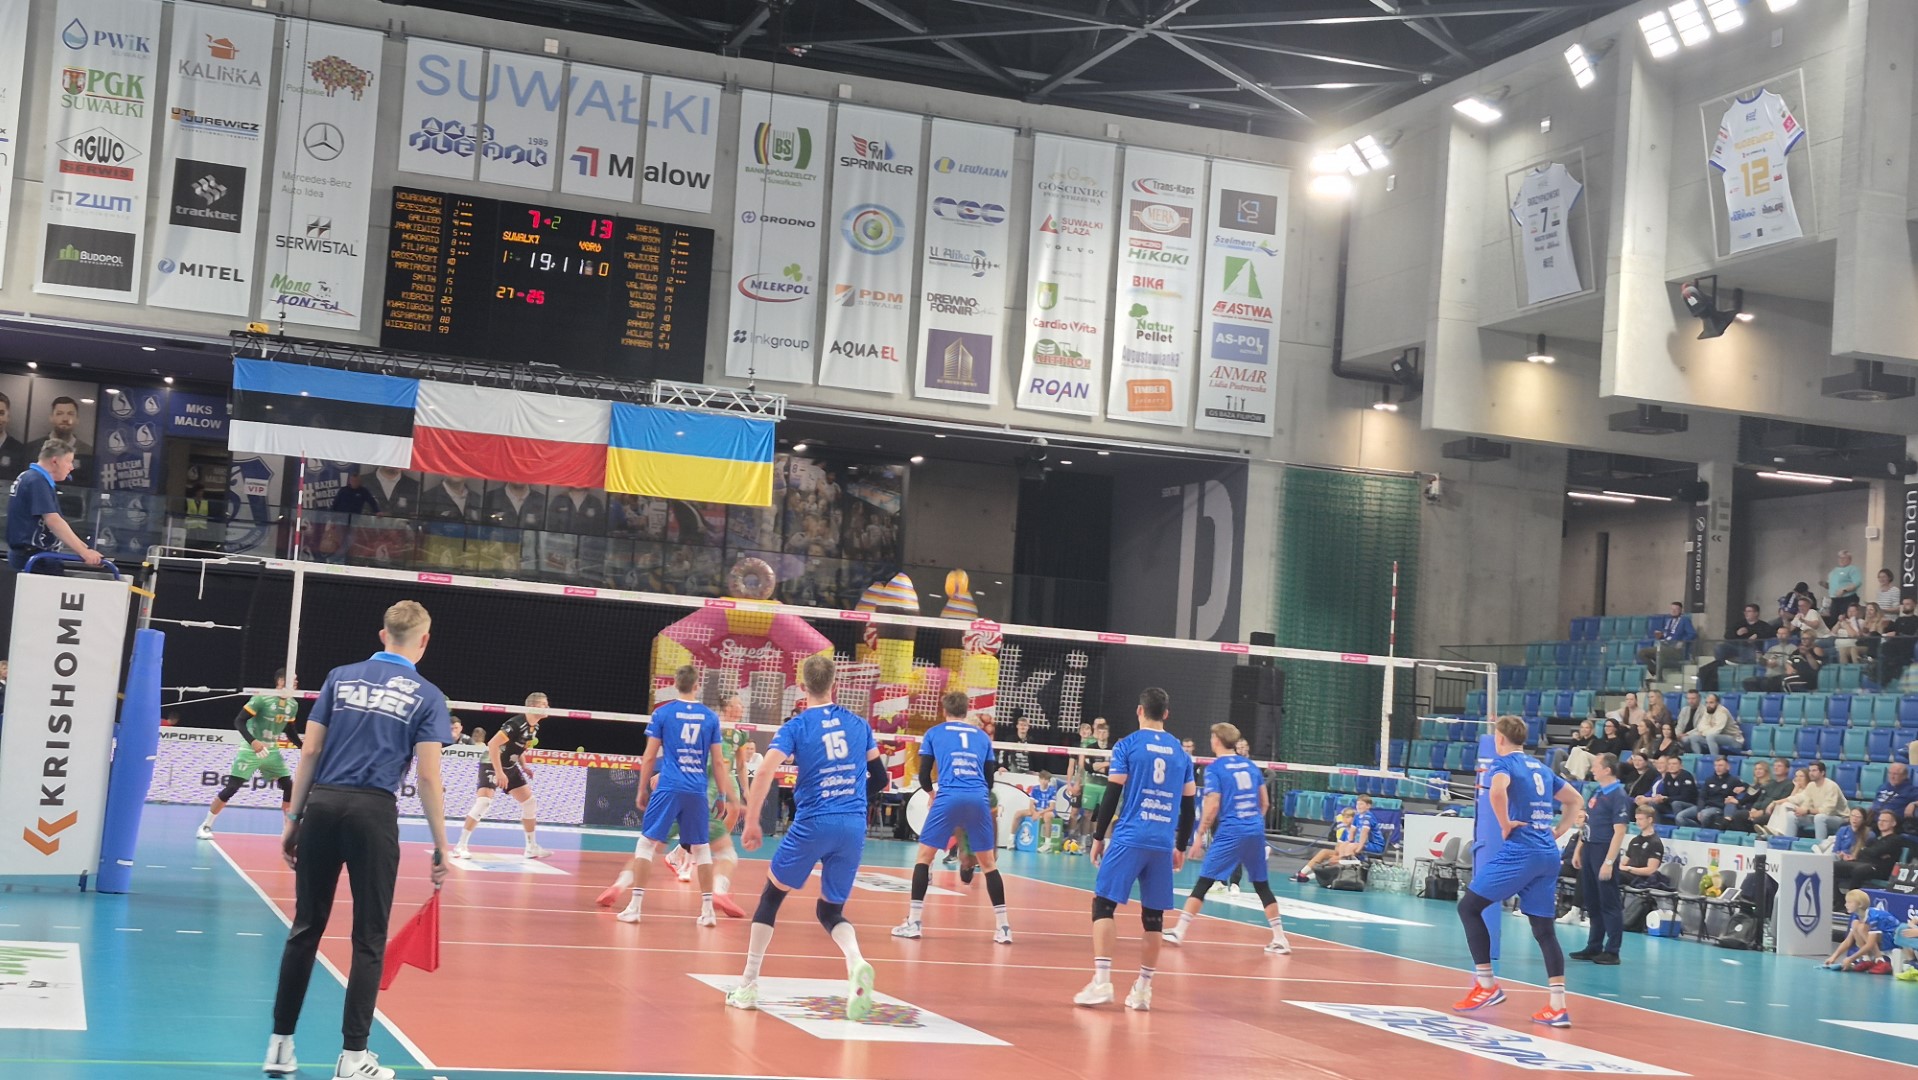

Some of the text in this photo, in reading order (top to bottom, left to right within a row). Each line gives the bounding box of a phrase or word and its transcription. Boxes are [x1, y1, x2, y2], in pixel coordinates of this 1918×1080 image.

[94, 30, 150, 53] PWiK
[178, 59, 262, 86] KALINKA
[86, 69, 144, 100] PGK
[415, 53, 711, 136] SUWAŁKI
[61, 94, 144, 119] SUWAŁKI
[74, 135, 125, 163] AGWO
[527, 136, 549, 148] 1989
[775, 138, 792, 155] BS
[64, 162, 130, 178] SERWIS
[608, 153, 711, 190] Malow
[840, 156, 914, 176] SPRINKLER
[958, 163, 1009, 178] LEWIATAN
[281, 170, 352, 189] Mercedes-Benz
[1741, 156, 1771, 198] 12
[281, 184, 324, 198] Auto Idea
[1037, 180, 1108, 199] GOŚCINIEC
[1153, 180, 1195, 196] Trans-Kaps
[175, 205, 238, 221] tracktec
[528, 209, 541, 229] 7
[760, 214, 816, 229] GRODNO
[1540, 206, 1549, 233] 7
[551, 215, 562, 230] 2
[590, 219, 613, 239] 13
[1061, 217, 1104, 230] SUWAŁKI
[1061, 225, 1092, 237] PLAZA
[276, 234, 358, 257] SERWISTAL
[1128, 247, 1190, 265] HiKOKI
[180, 262, 245, 283] MITEL
[270, 273, 312, 294] Mona
[750, 280, 811, 296] MLEKPOL
[1132, 275, 1165, 290] BIKA
[859, 289, 903, 304] PDM
[926, 292, 978, 308] DREWNO
[930, 303, 973, 316] FORNIR
[1033, 317, 1068, 330] Cardio
[1136, 318, 1175, 333] Natur
[1136, 330, 1173, 344] Pellet
[1215, 333, 1263, 348] AS-POL
[1210, 365, 1268, 384] ANMAR
[1029, 378, 1090, 402] ROAN
[186, 403, 213, 415] MKS
[174, 415, 222, 430] MALOW
[247, 485, 265, 494] VIP
[39, 592, 86, 807] KRISHOME
[159, 731, 224, 742] MPORTEX
[680, 723, 701, 744] 47
[959, 732, 969, 749] 1
[822, 730, 849, 761] 15
[524, 749, 582, 761] MIEJSCE
[583, 752, 598, 761] NA
[1153, 757, 1166, 785] 8
[1233, 771, 1253, 791] 10
[1533, 772, 1545, 796] 9
